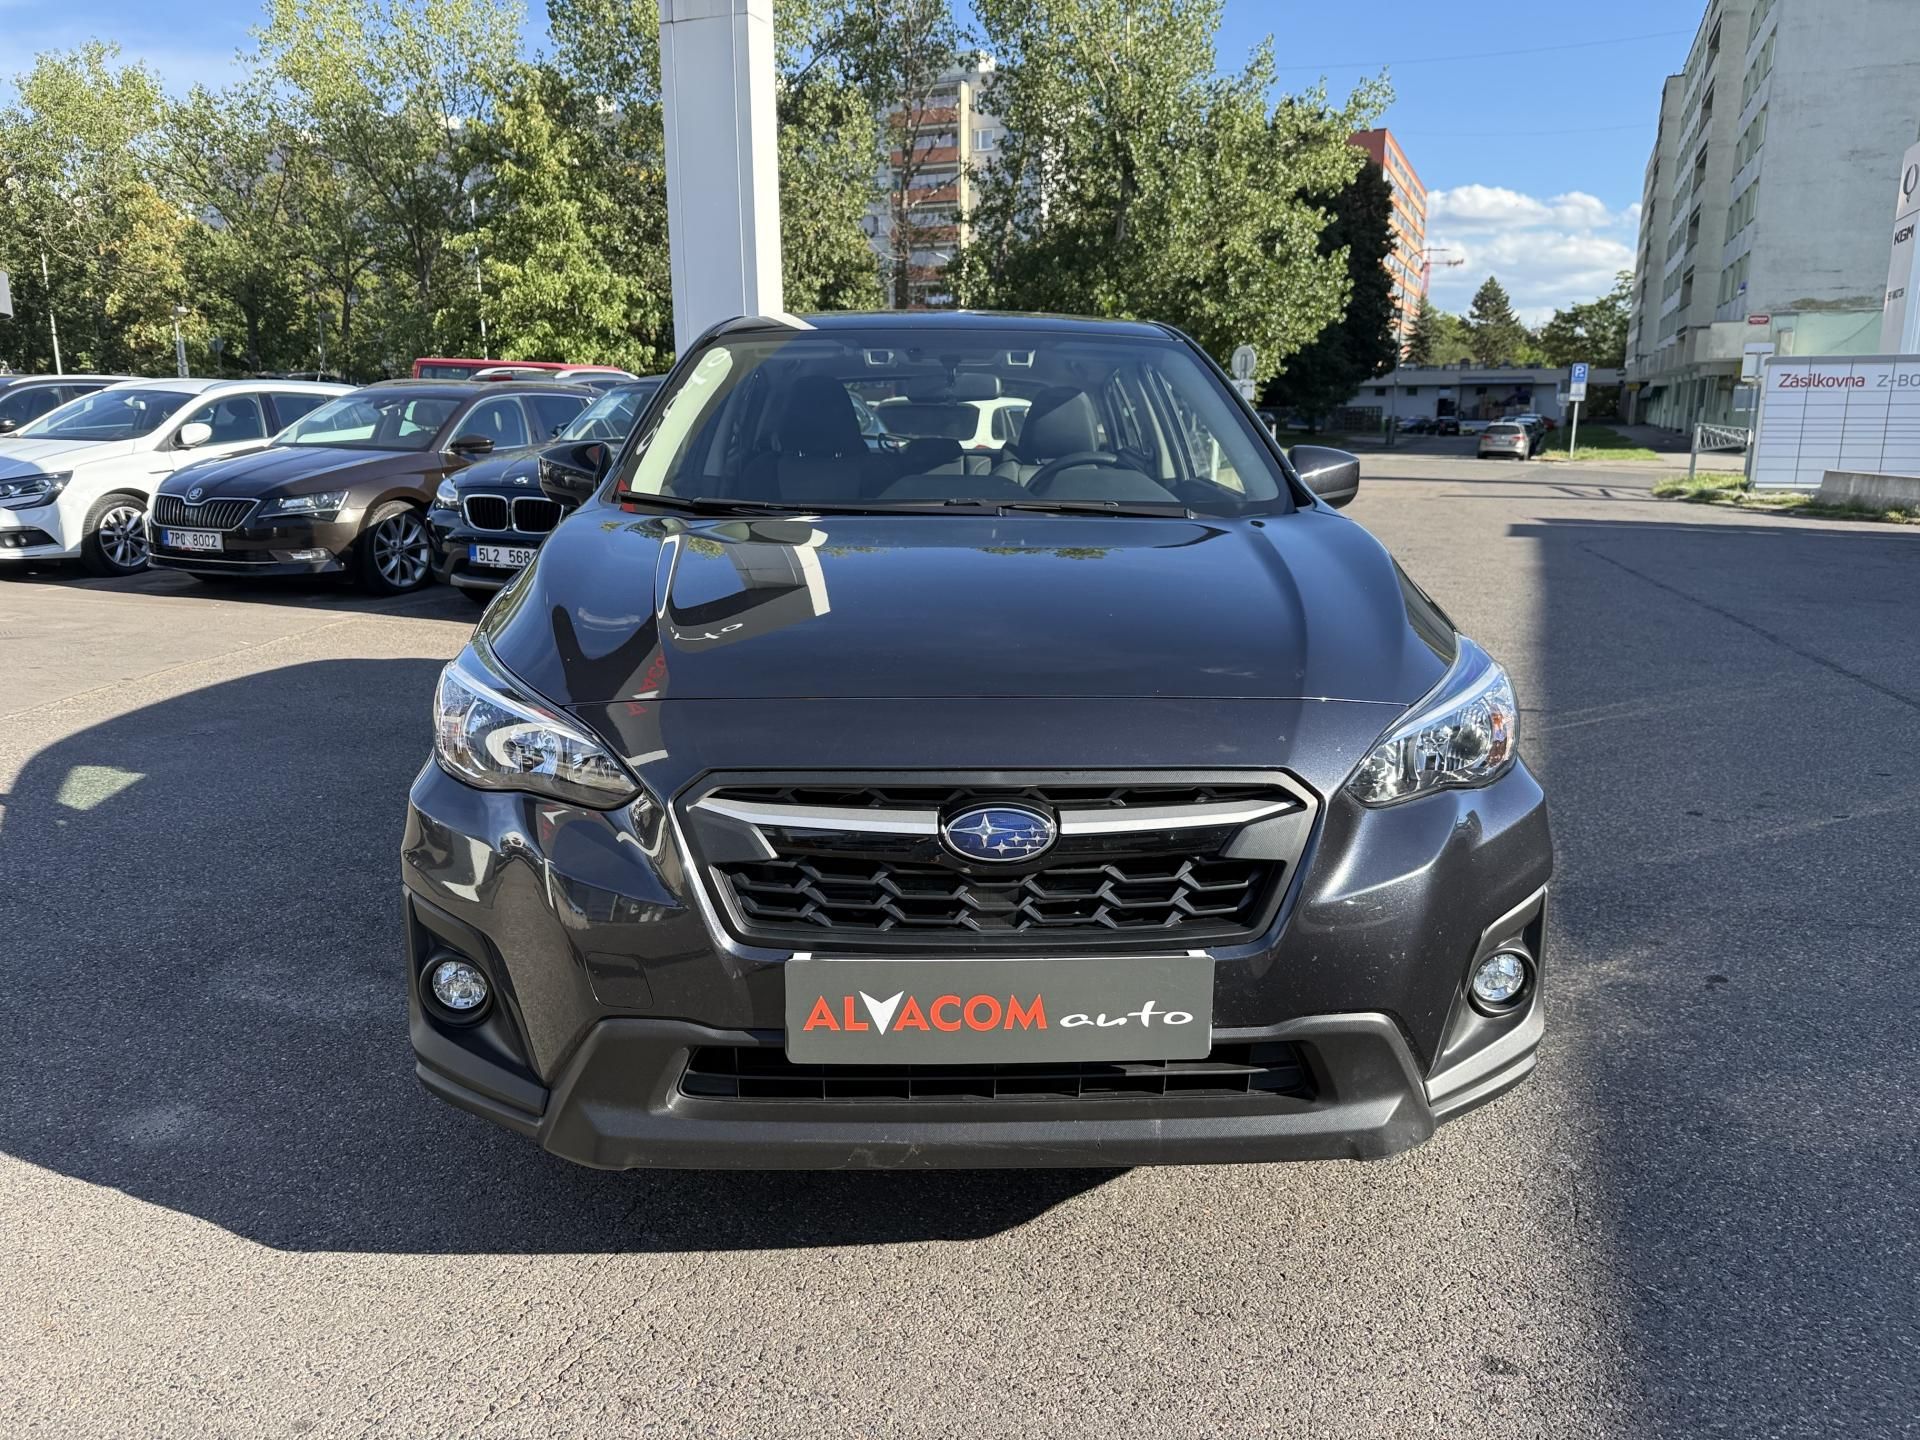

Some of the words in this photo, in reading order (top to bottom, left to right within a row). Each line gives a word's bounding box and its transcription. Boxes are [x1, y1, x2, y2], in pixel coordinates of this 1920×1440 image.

[1893, 224, 1915, 246] KGM
[1778, 373, 1866, 389] Zásilkovna
[192, 533, 217, 548] 8002
[479, 547, 500, 562] 5L2
[802, 990, 1048, 1036] ALVACOM
[1059, 1000, 1194, 1028] auto
